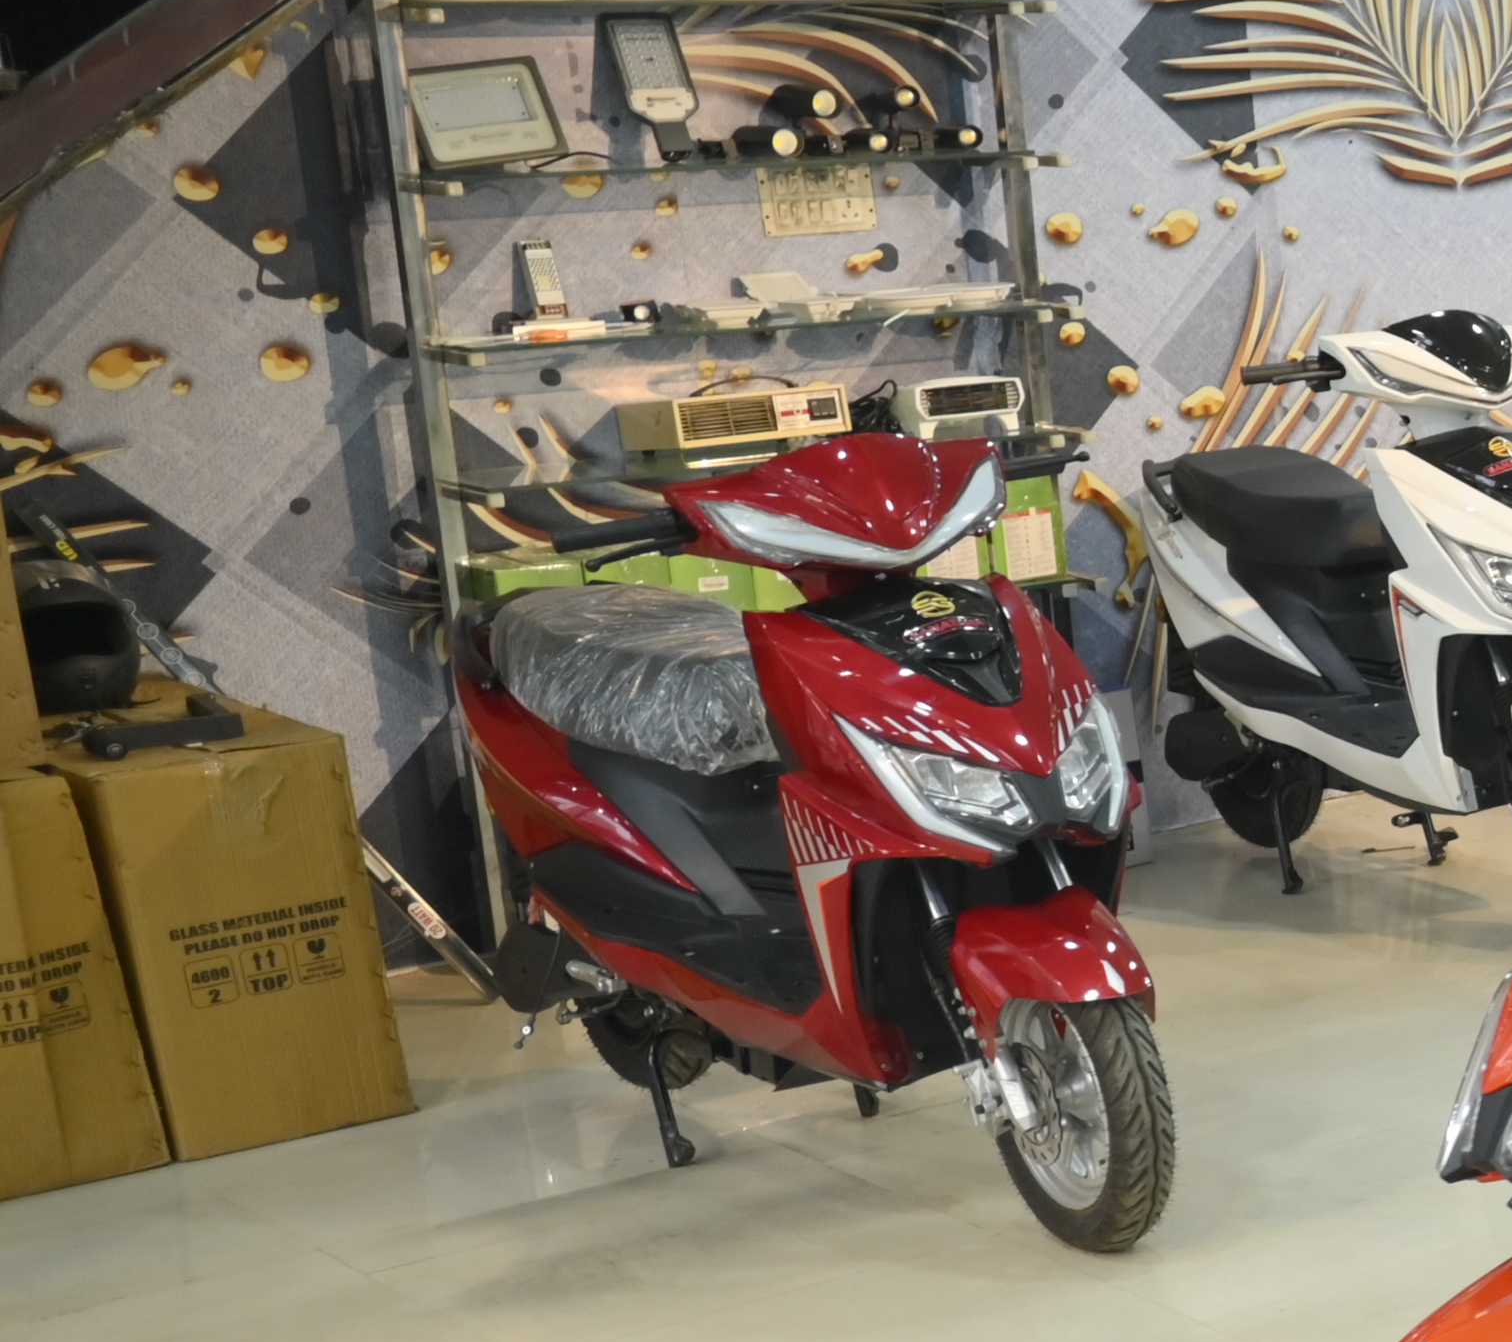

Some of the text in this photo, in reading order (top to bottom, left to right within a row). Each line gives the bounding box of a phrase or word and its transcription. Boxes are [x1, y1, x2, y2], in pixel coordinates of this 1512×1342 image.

[56, 541, 78, 561] LED
[169, 896, 348, 942] GLASS MATERIAL INSIDE
[410, 905, 443, 936] 20 WATT
[184, 915, 340, 955] PLEASE DO NOT DROP
[39, 942, 91, 965] INSIDE
[41, 961, 83, 982] DROP
[191, 966, 231, 985] 4600
[249, 973, 289, 993] TOP
[208, 989, 222, 1004] 2
[0, 1025, 42, 1044] TOP
